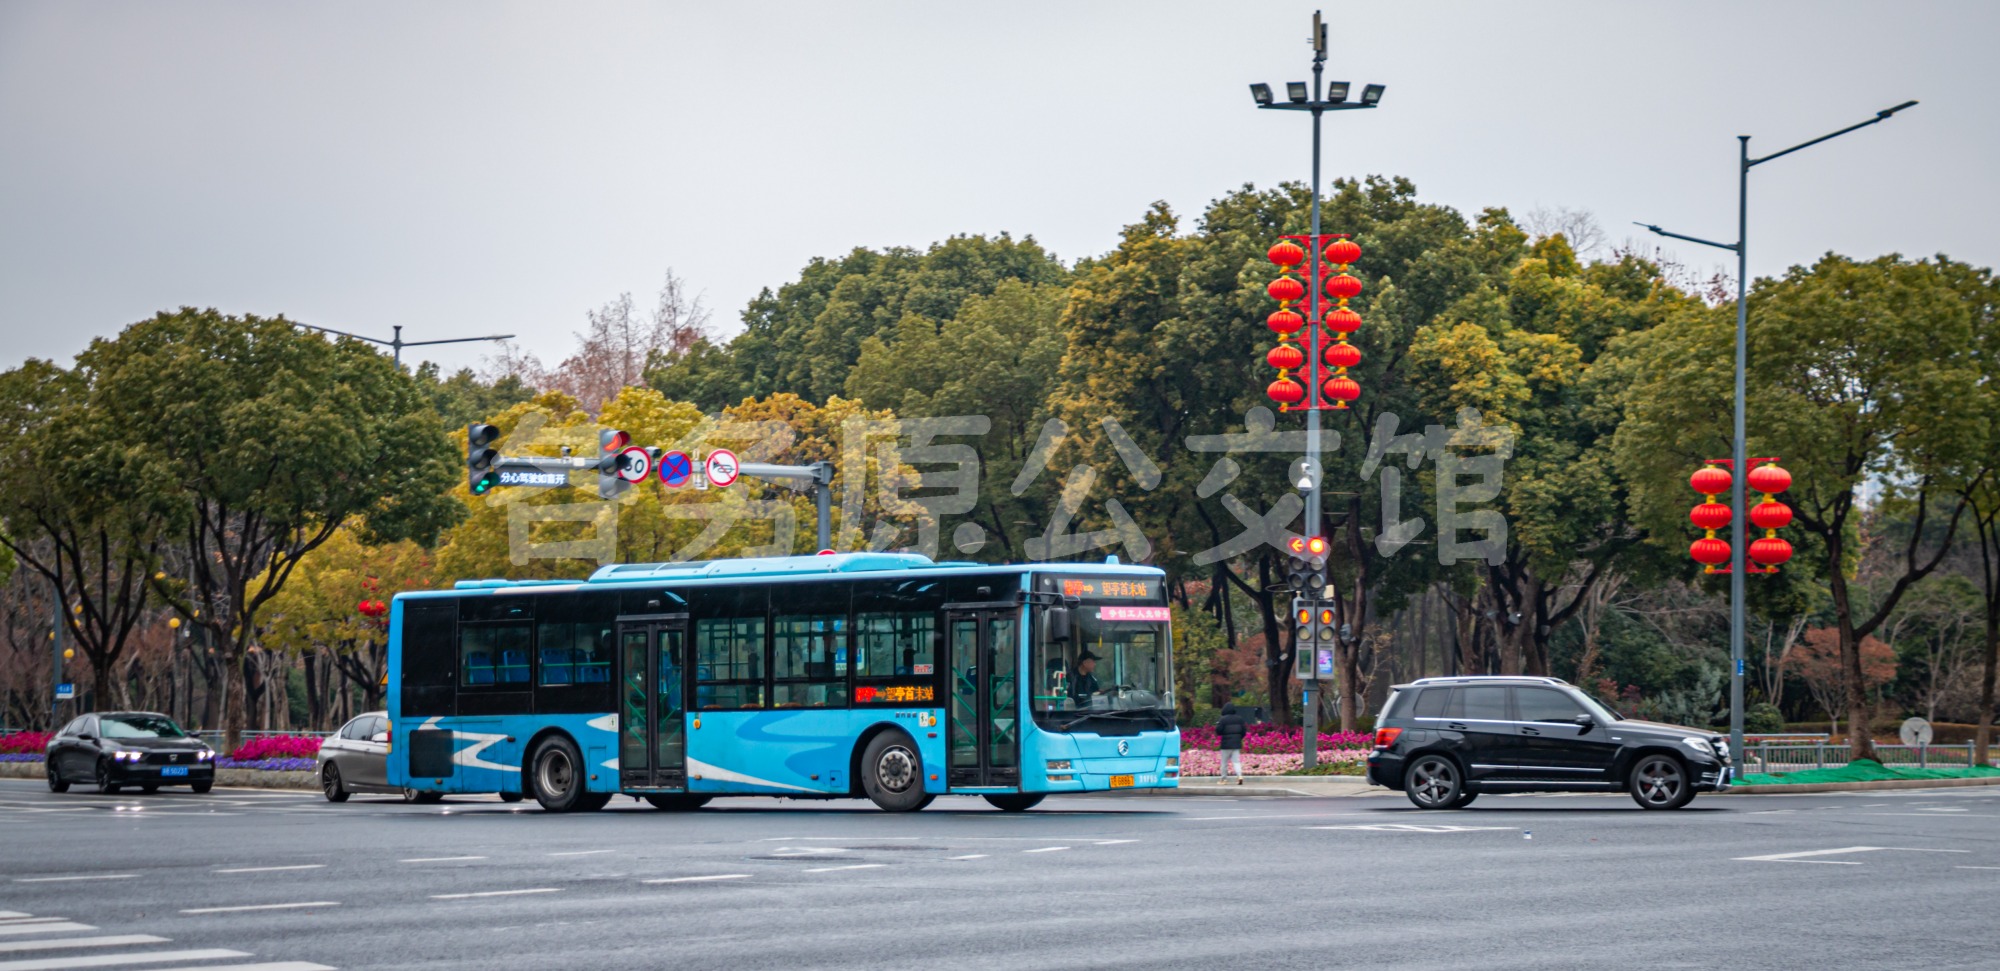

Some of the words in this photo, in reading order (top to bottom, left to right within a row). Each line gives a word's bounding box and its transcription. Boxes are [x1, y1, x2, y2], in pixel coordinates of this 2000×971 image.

[500, 471, 566, 485] 分心驾驶如盲开
[1101, 581, 1147, 597] 望亭首末站
[885, 685, 934, 702] 望亭首末站
